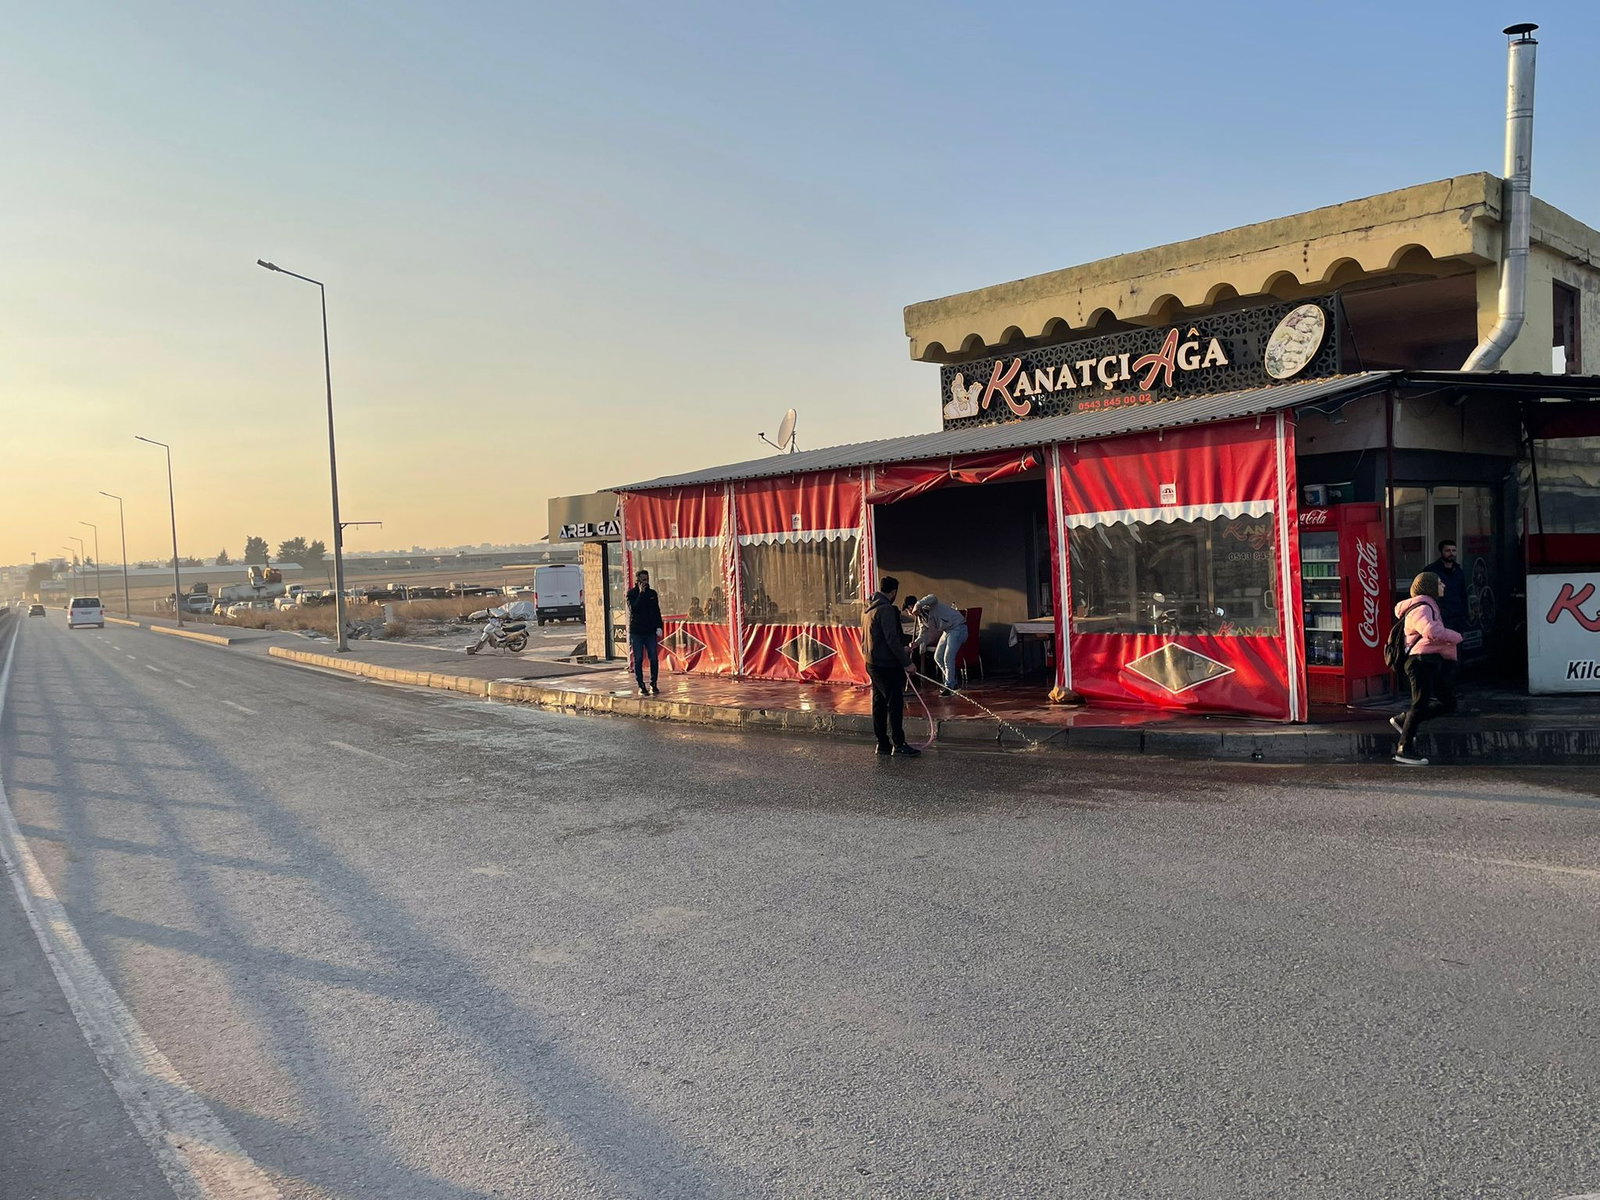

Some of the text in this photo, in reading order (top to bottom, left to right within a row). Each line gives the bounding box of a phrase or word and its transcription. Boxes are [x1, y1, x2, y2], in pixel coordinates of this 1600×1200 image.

[982, 353, 1132, 416] KANATÇI
[1078, 393, 1152, 410] 0543 845 00 02
[559, 523, 593, 539] AREL
[1356, 536, 1380, 648] Coca-Cola
